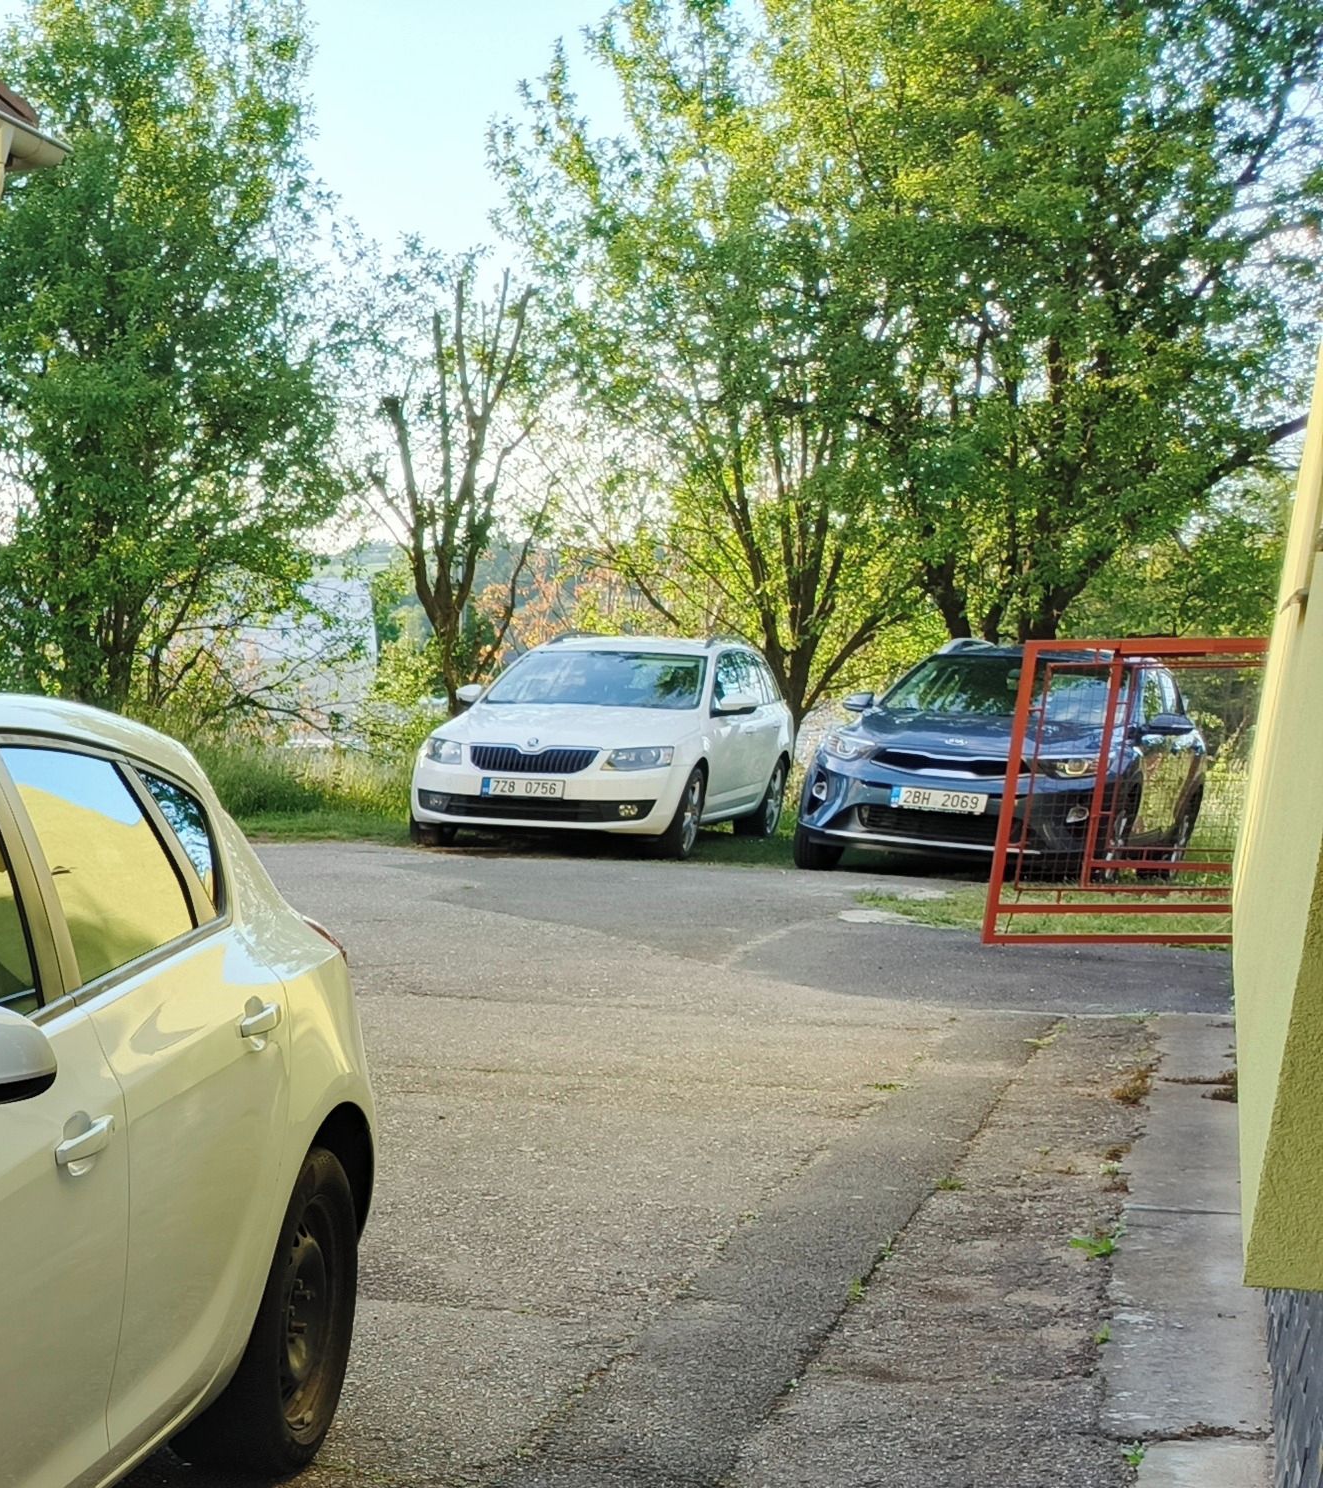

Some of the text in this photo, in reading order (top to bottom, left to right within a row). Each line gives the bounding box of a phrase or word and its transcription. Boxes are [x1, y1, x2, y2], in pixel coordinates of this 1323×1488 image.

[492, 780, 516, 793] 7Z8
[524, 781, 557, 795] 0756
[903, 790, 932, 805] 2BH
[941, 793, 980, 809] 2069
